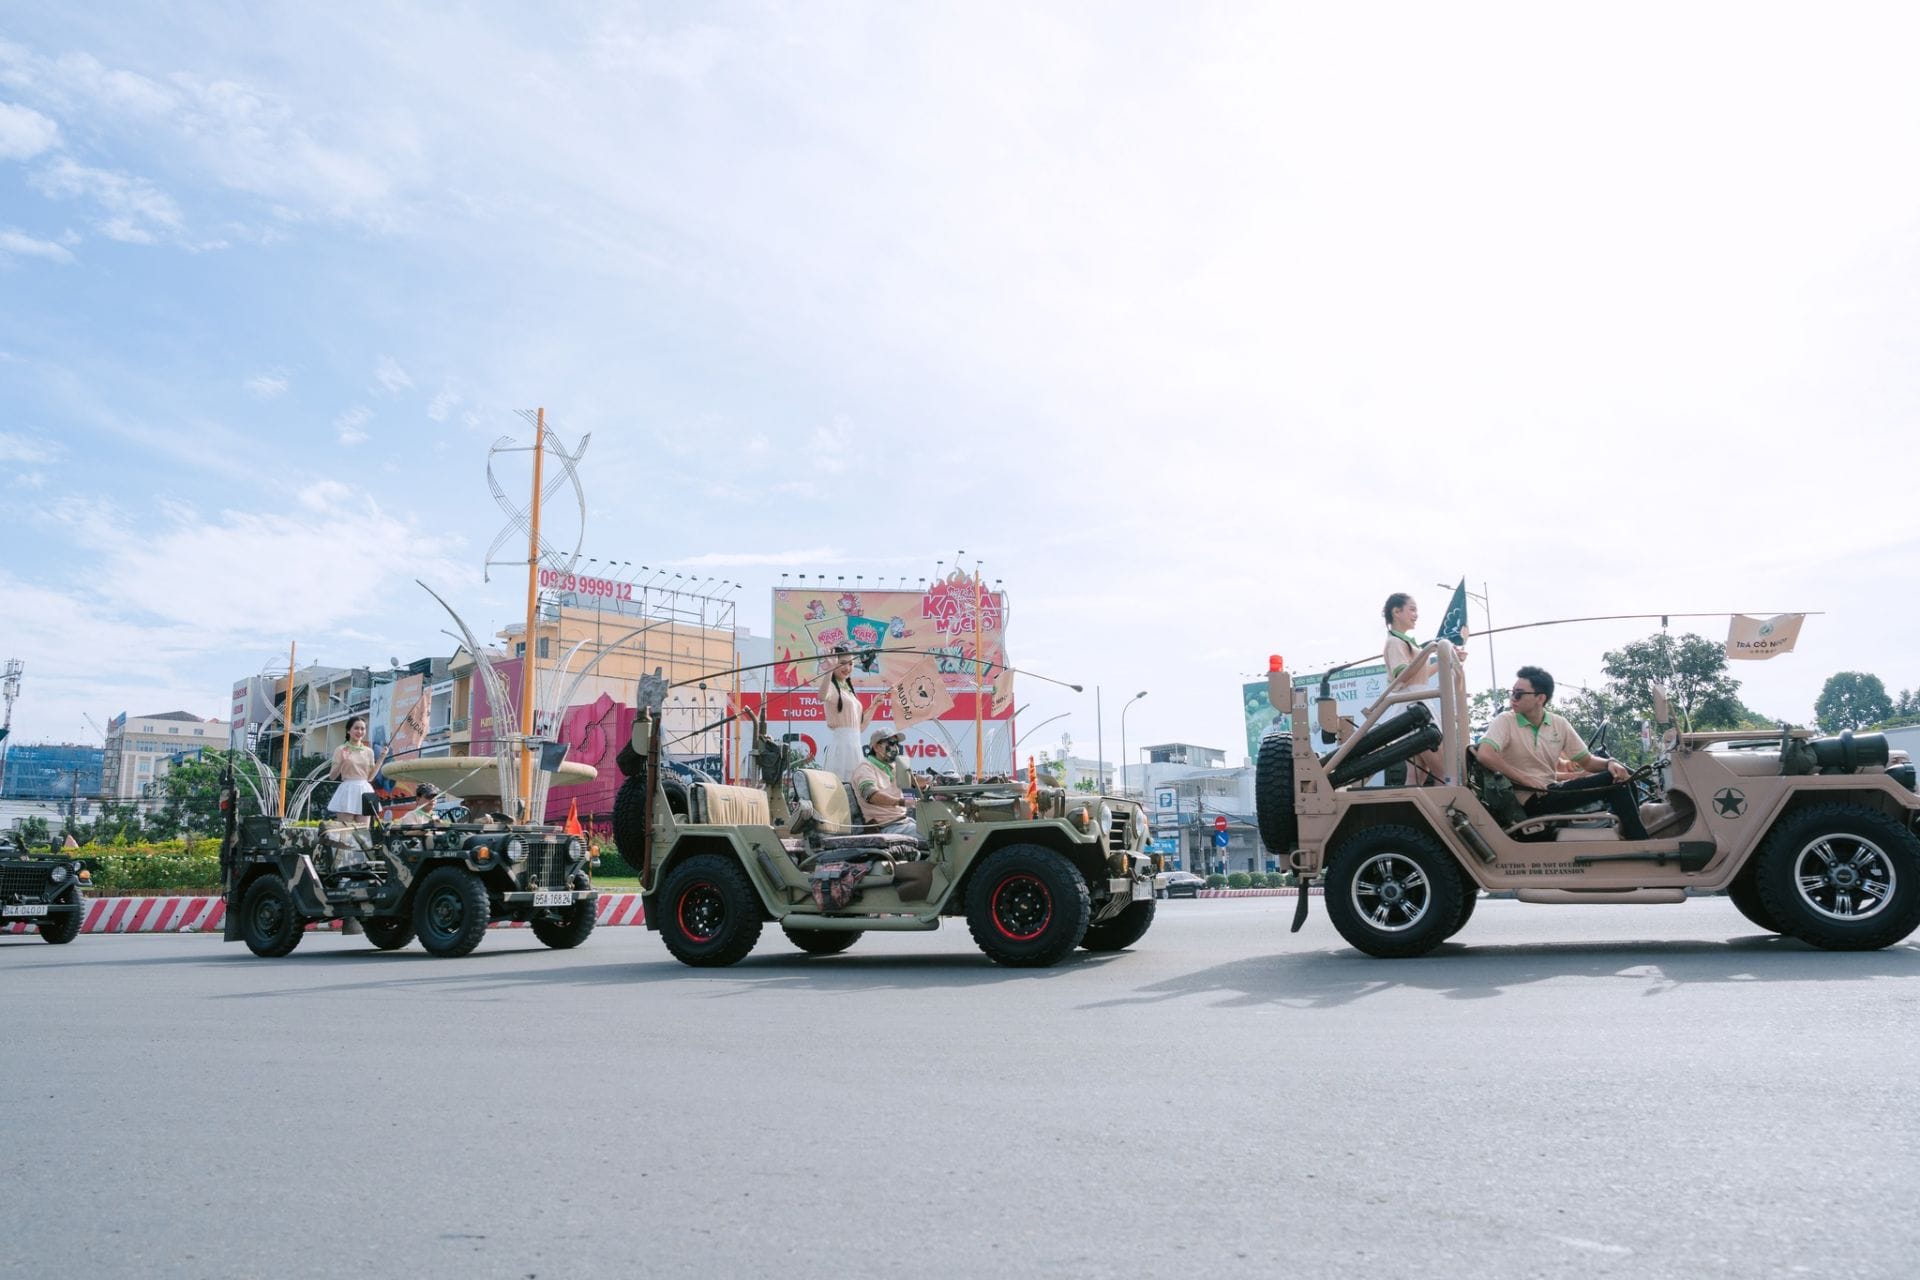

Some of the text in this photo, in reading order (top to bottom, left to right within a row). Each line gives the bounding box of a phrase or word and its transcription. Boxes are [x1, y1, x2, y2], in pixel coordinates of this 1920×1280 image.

[578, 576, 614, 598] 9999
[616, 583, 632, 601] 12
[782, 708, 802, 718] THU
[803, 707, 817, 718] CŨ
